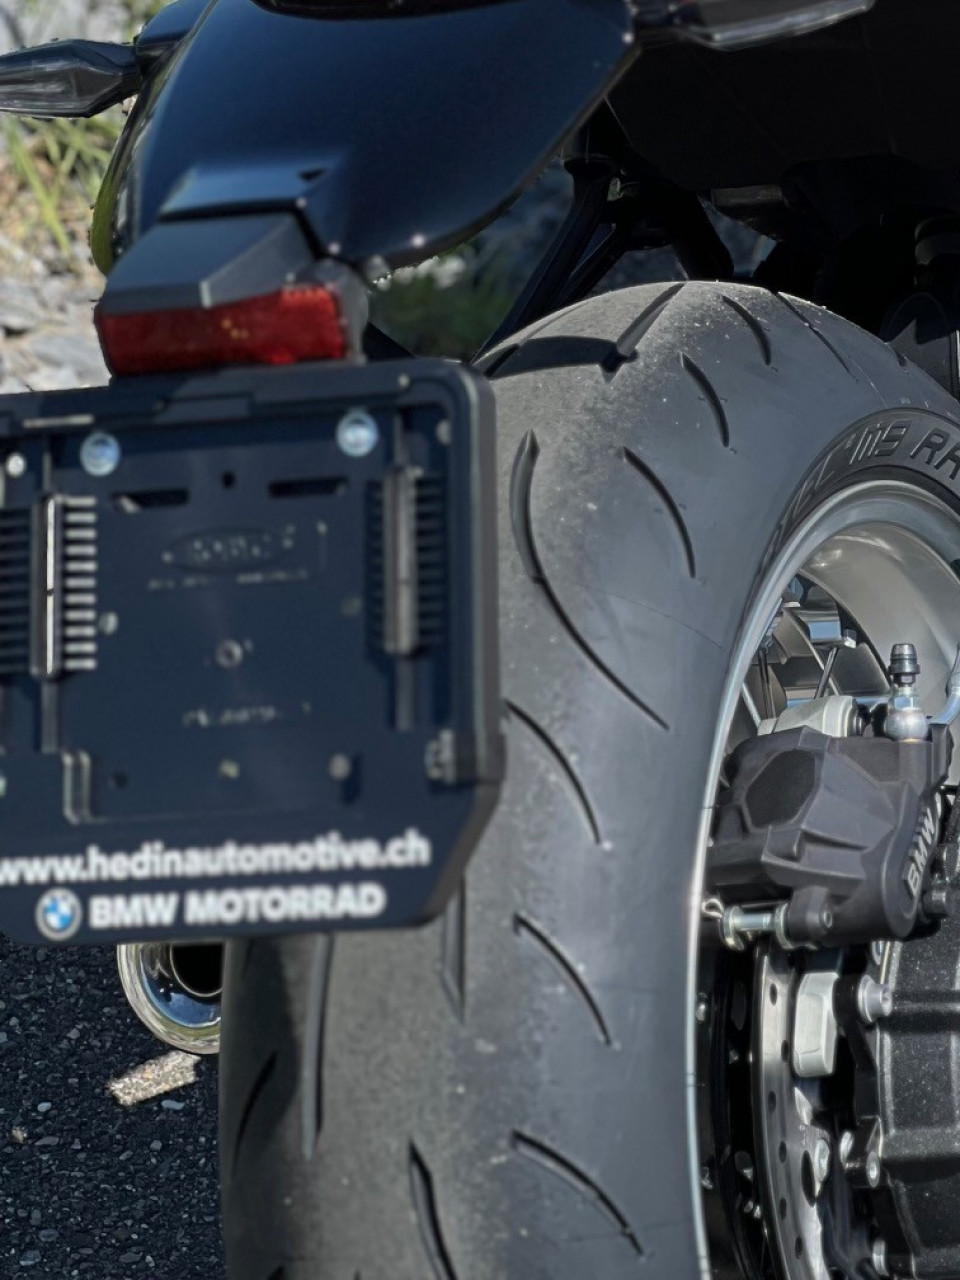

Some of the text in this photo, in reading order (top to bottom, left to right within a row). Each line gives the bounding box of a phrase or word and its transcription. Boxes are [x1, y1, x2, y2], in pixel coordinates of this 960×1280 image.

[0, 826, 431, 886] www.hedinautomotive.ch
[908, 807, 935, 897] BMW
[88, 881, 387, 929] BMW MOTORRAD
